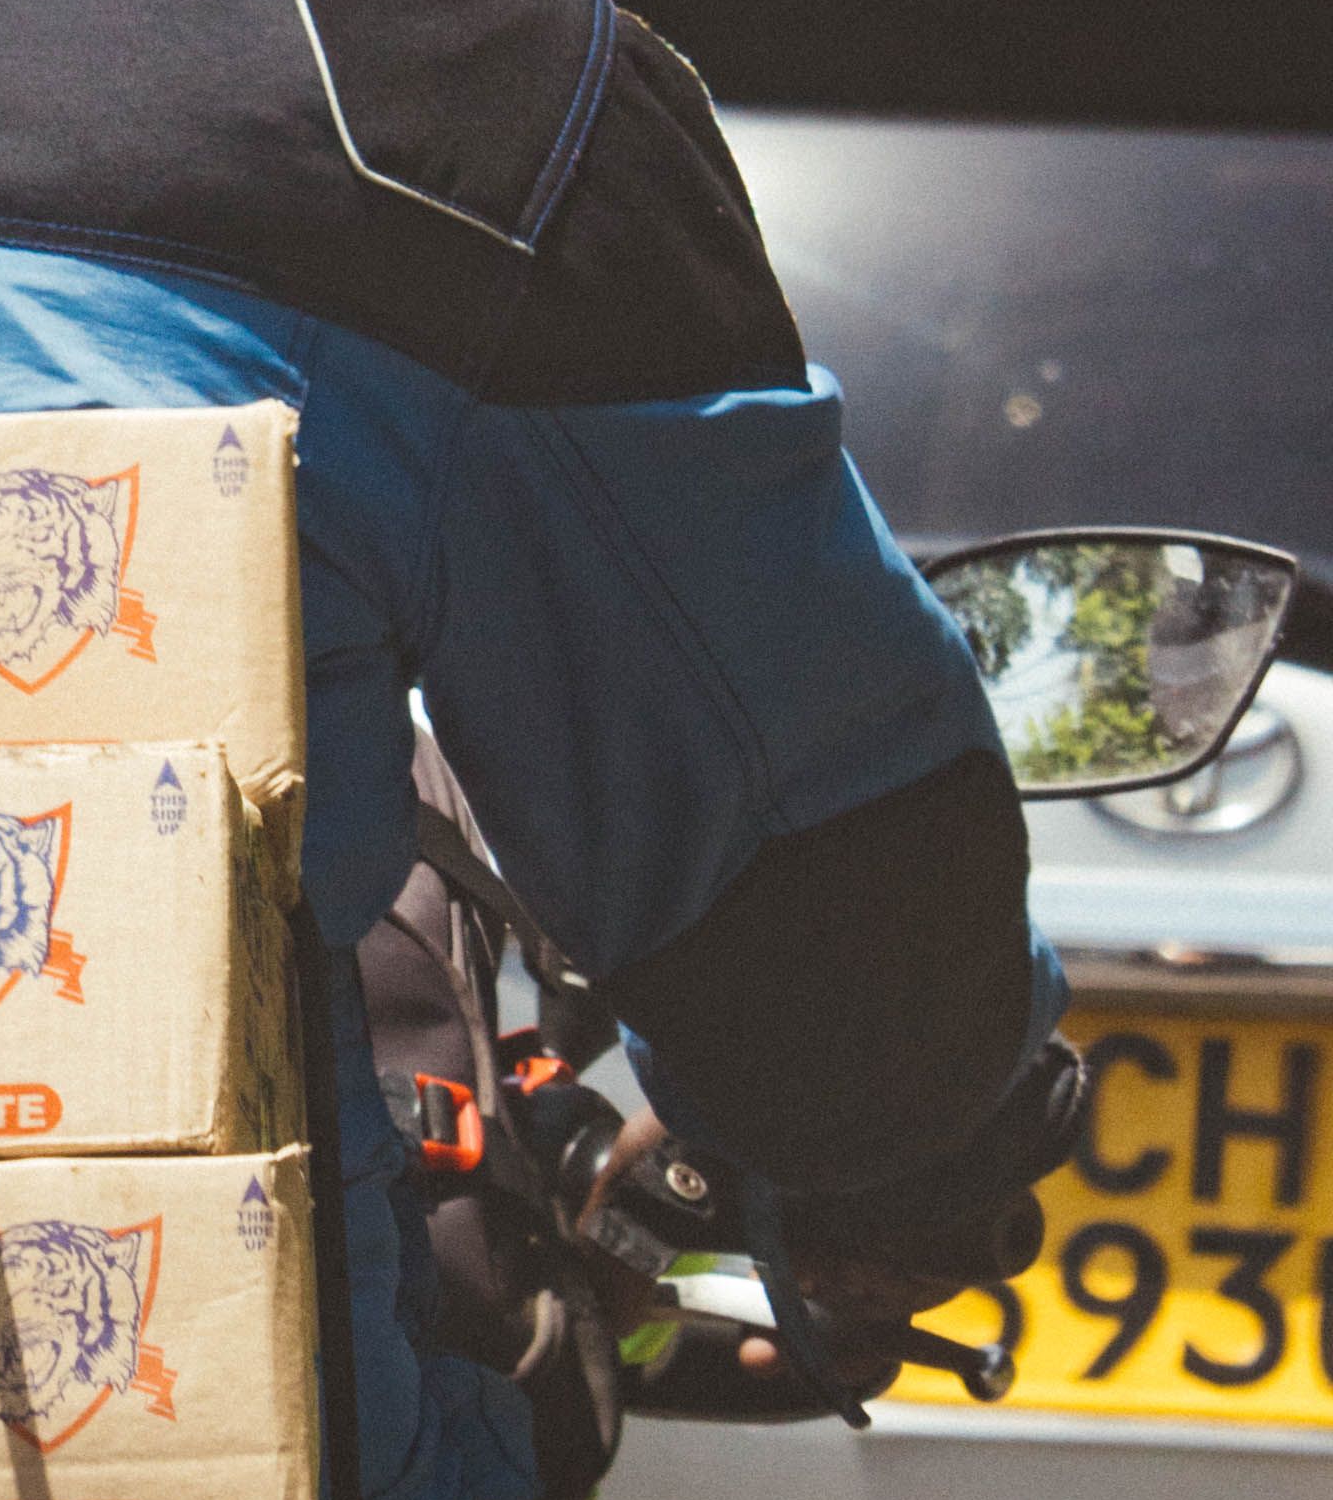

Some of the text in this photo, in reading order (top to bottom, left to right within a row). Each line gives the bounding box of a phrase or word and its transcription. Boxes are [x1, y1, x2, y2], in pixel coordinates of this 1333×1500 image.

[151, 794, 188, 807] THIS
[151, 808, 187, 821] SIDE
[157, 822, 180, 836] UP
[237, 1209, 273, 1223] THIS
[237, 1224, 273, 1238] SIDE
[245, 1239, 267, 1253] UP
